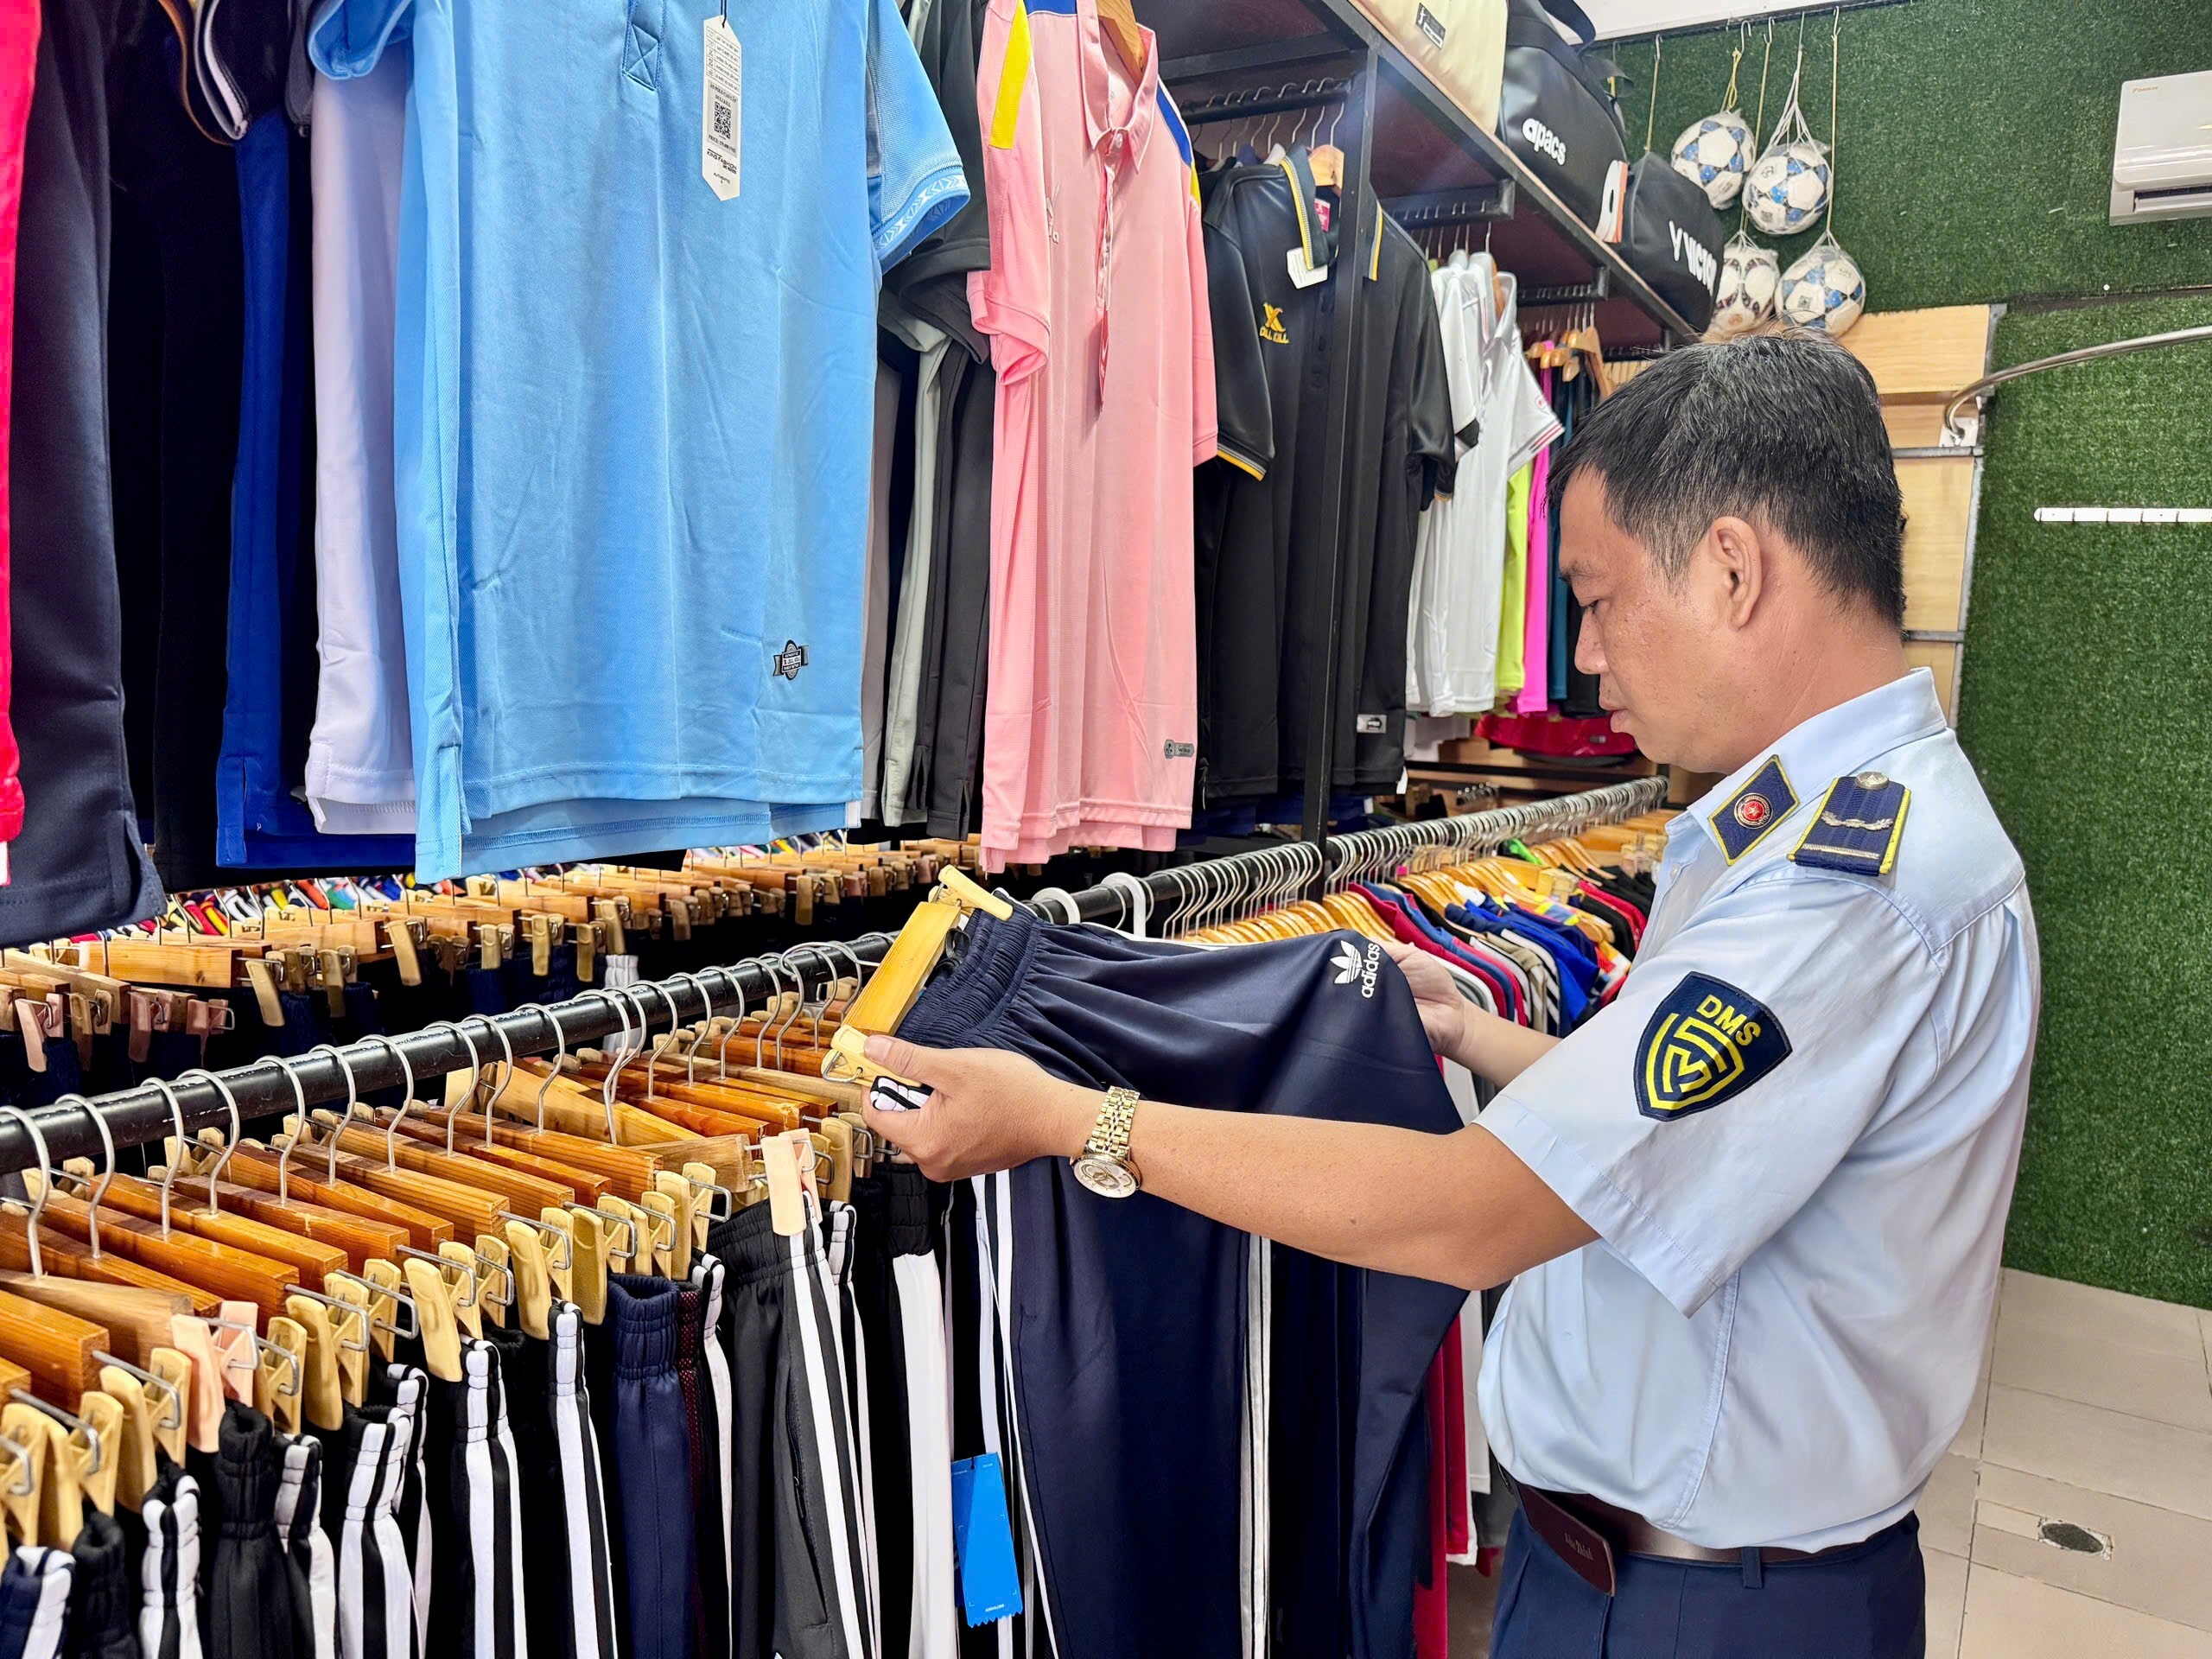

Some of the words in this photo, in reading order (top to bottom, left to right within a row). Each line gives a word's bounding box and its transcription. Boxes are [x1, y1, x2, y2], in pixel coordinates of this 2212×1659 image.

[1522, 118, 1567, 165] apacs
[1361, 943, 1381, 999] adidas
[1696, 994, 1762, 1046] DMS
